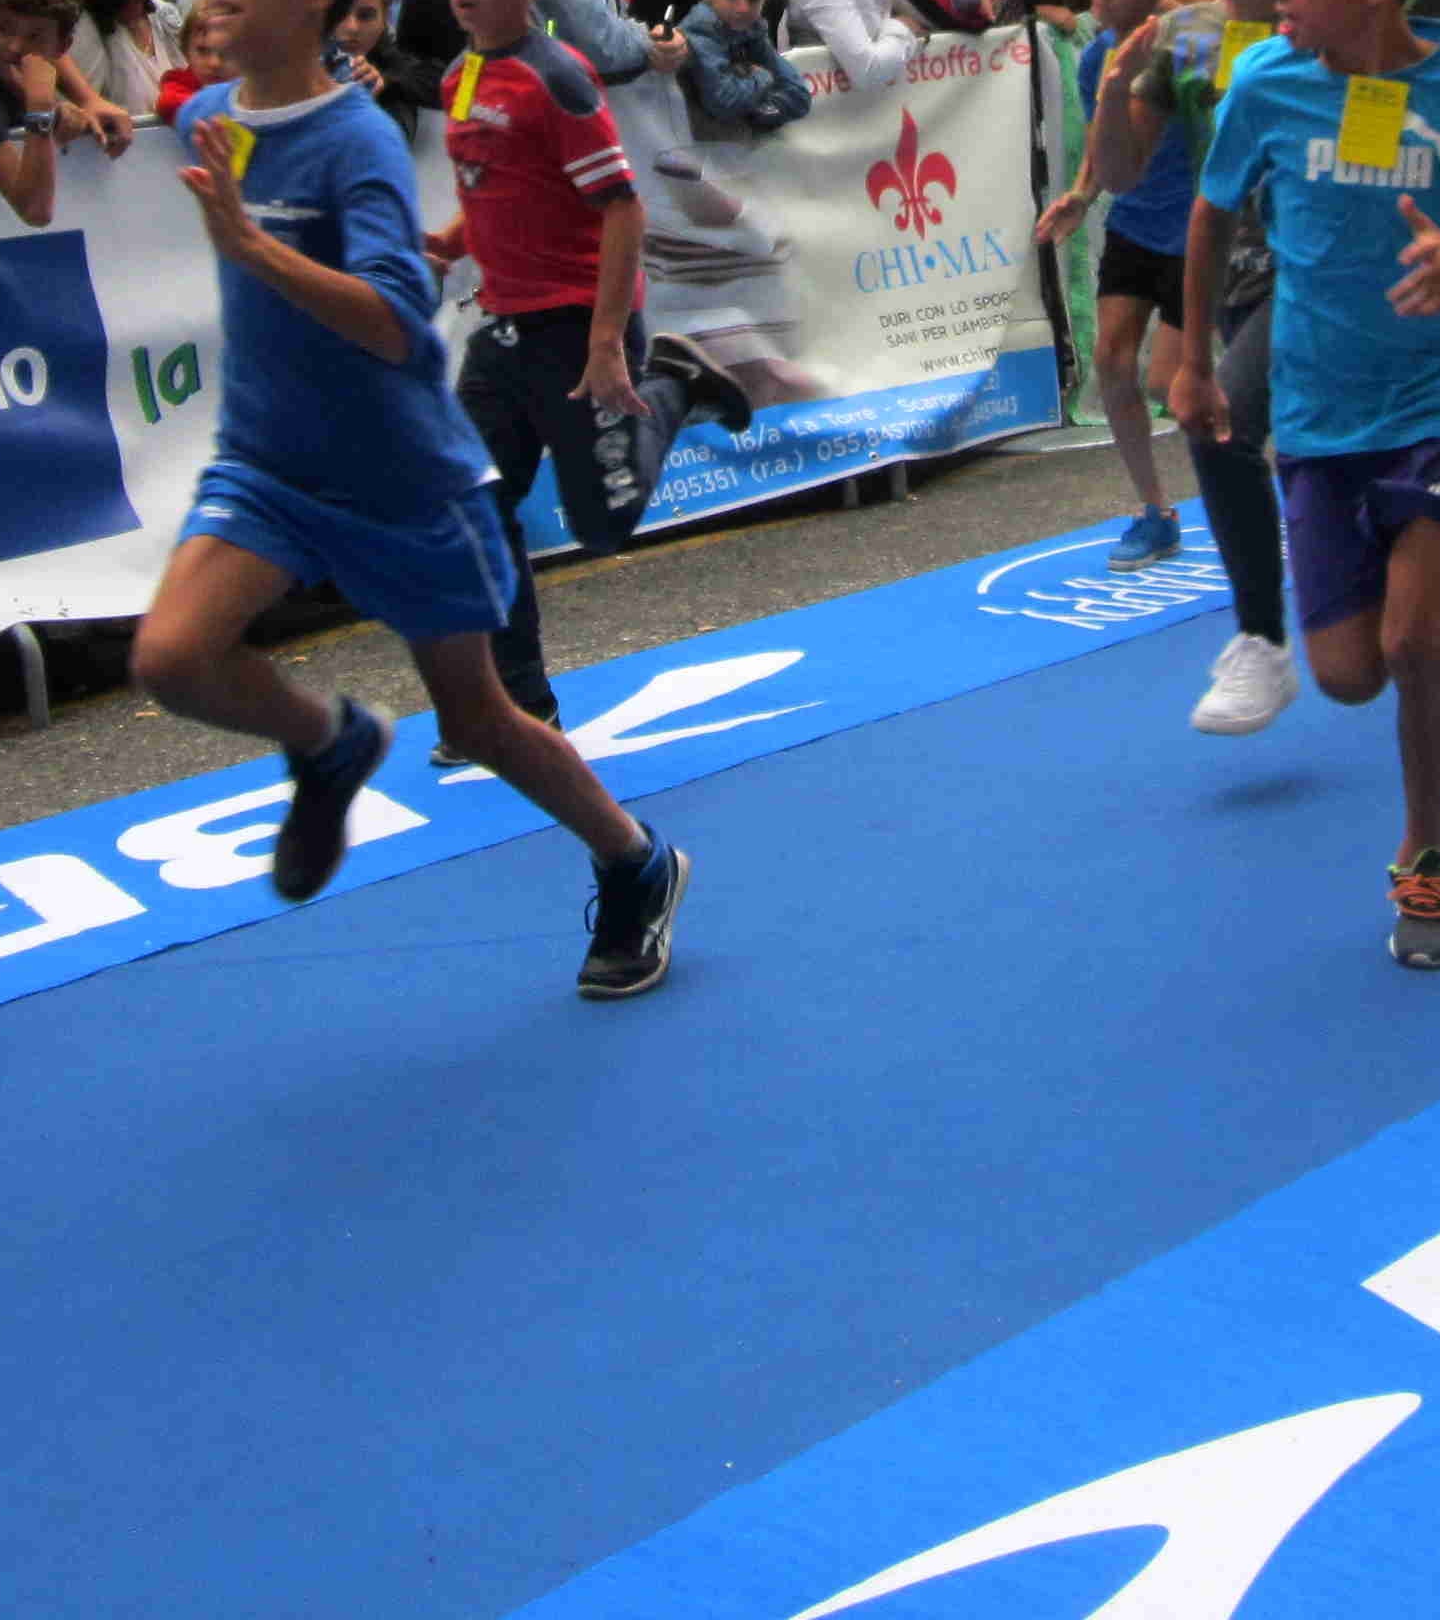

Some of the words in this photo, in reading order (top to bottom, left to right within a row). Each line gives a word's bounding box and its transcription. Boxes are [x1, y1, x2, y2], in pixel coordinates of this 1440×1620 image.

[905, 45, 982, 84] stoffa
[916, 305, 945, 321] CON
[950, 301, 968, 316] LO
[922, 326, 946, 341] PER
[130, 341, 201, 424] la
[729, 423, 782, 453] 16/a
